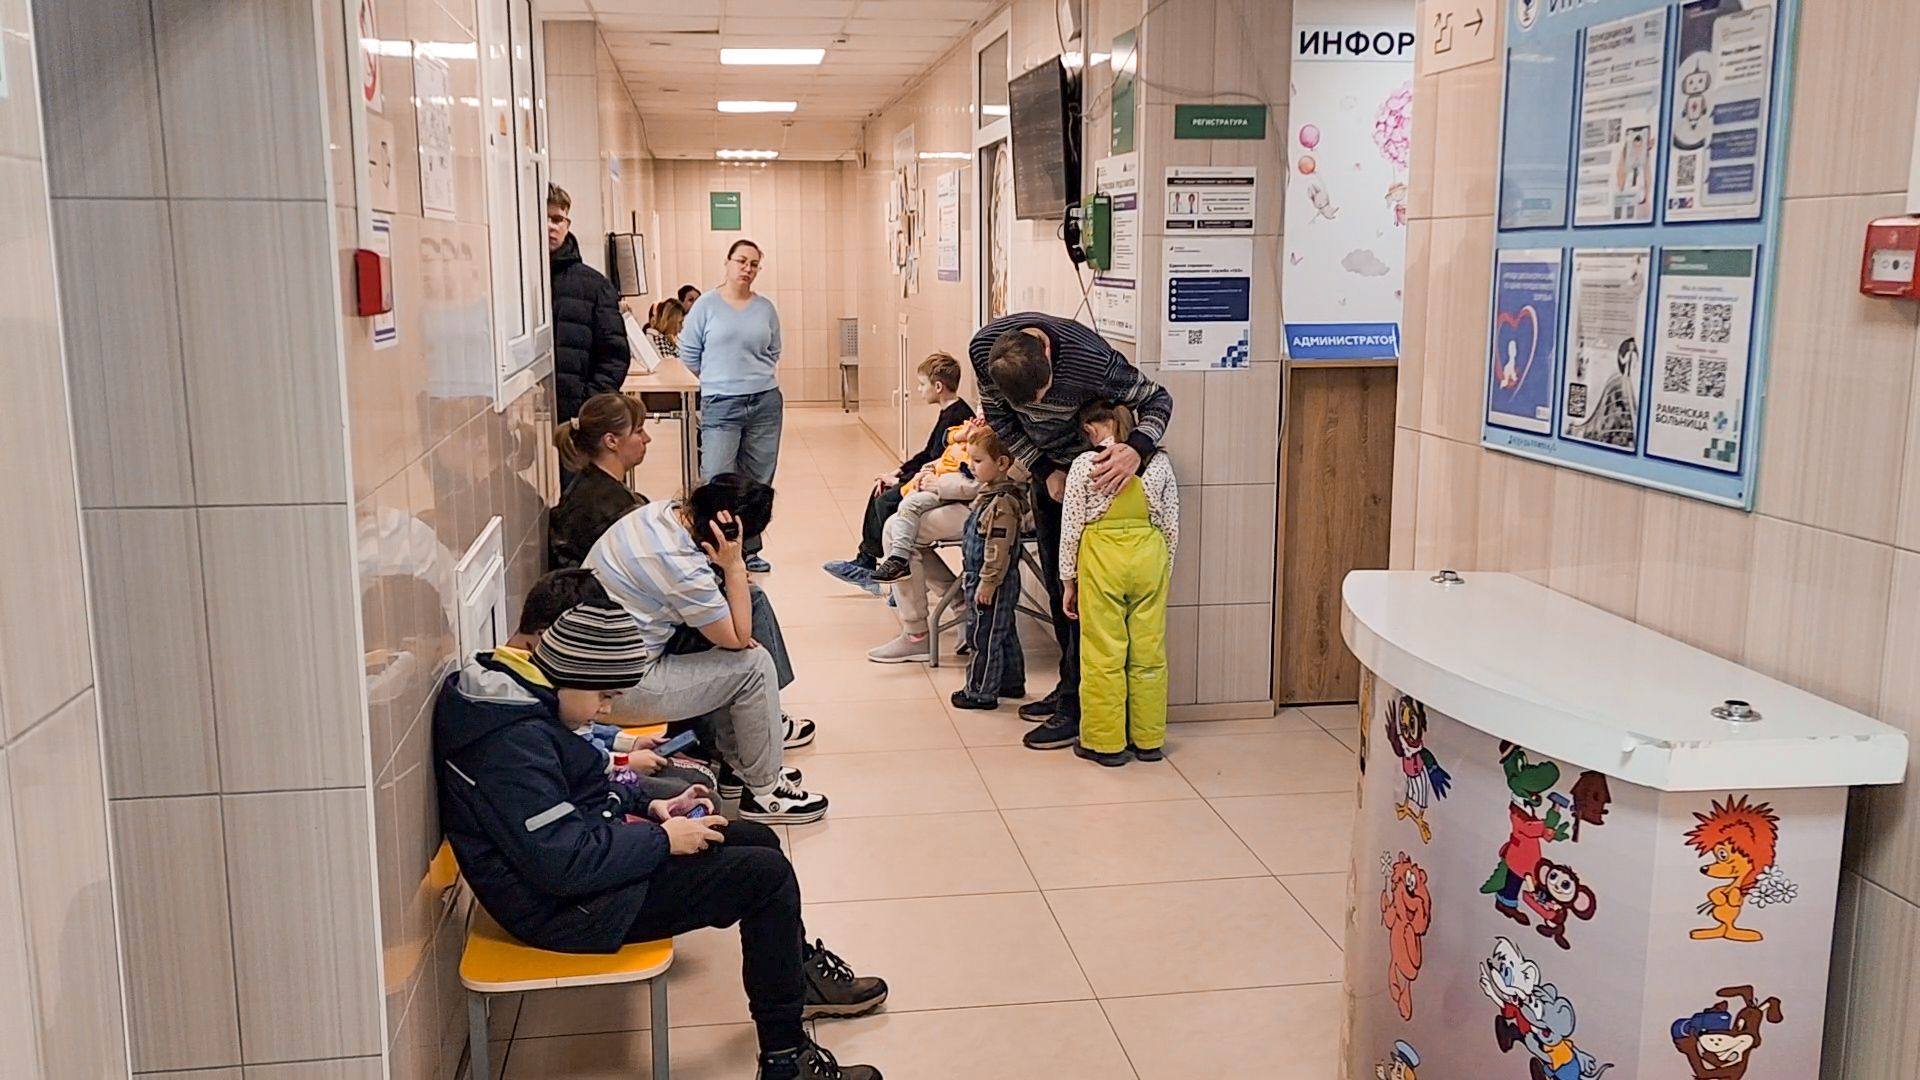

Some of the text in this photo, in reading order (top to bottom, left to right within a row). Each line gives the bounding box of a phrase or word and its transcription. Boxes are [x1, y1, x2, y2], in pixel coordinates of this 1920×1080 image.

[1299, 31, 1415, 56] ИНФОР
[1192, 118, 1249, 127] РЕГИСТРАТУРА
[1292, 335, 1397, 348] АДМИНИСТРАТОР
[1656, 403, 1710, 419] РАМЕНСКАЯ
[1655, 414, 1708, 430] БОЛЬНИЦА
